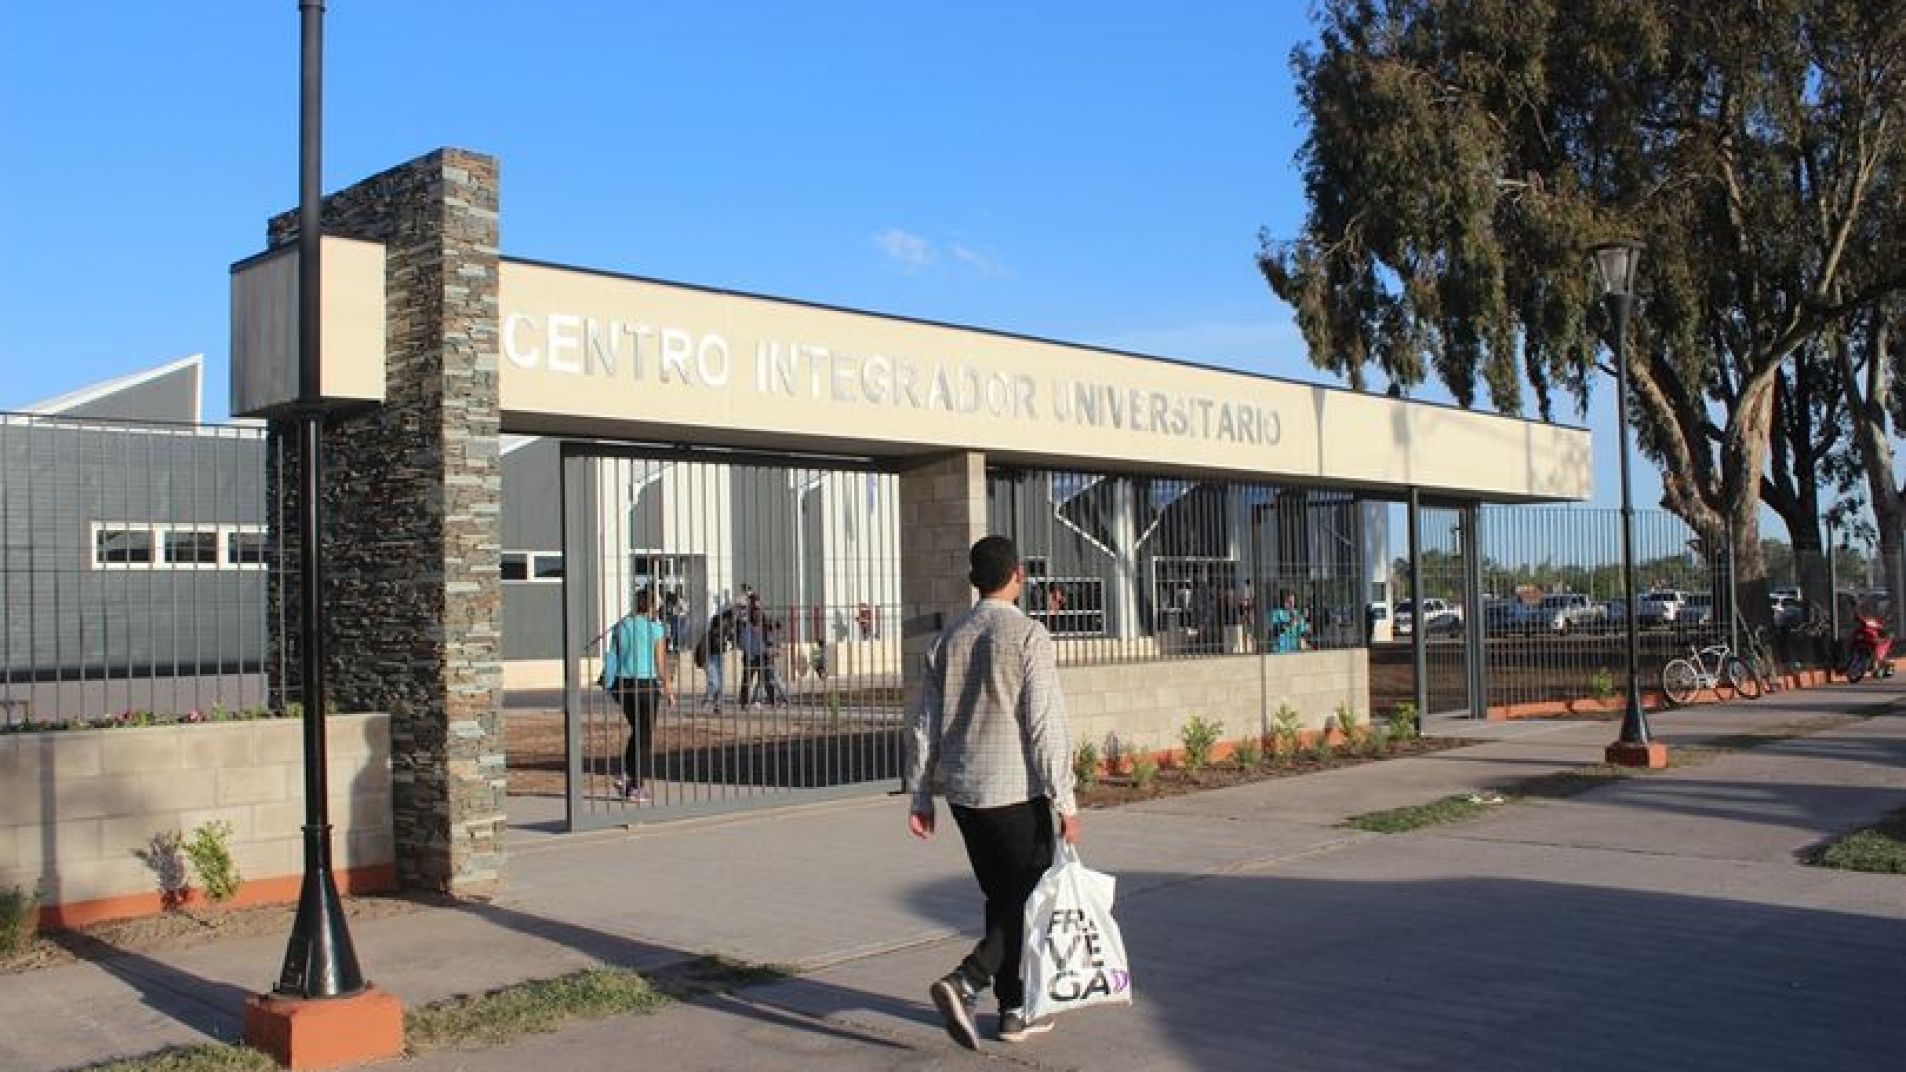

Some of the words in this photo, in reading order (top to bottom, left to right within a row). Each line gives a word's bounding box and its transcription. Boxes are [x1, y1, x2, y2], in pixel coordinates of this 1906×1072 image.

[504, 312, 731, 388] CENTRO
[755, 337, 1038, 421] INTEGRADOR
[1052, 374, 1282, 447] UNIVERSITARIO
